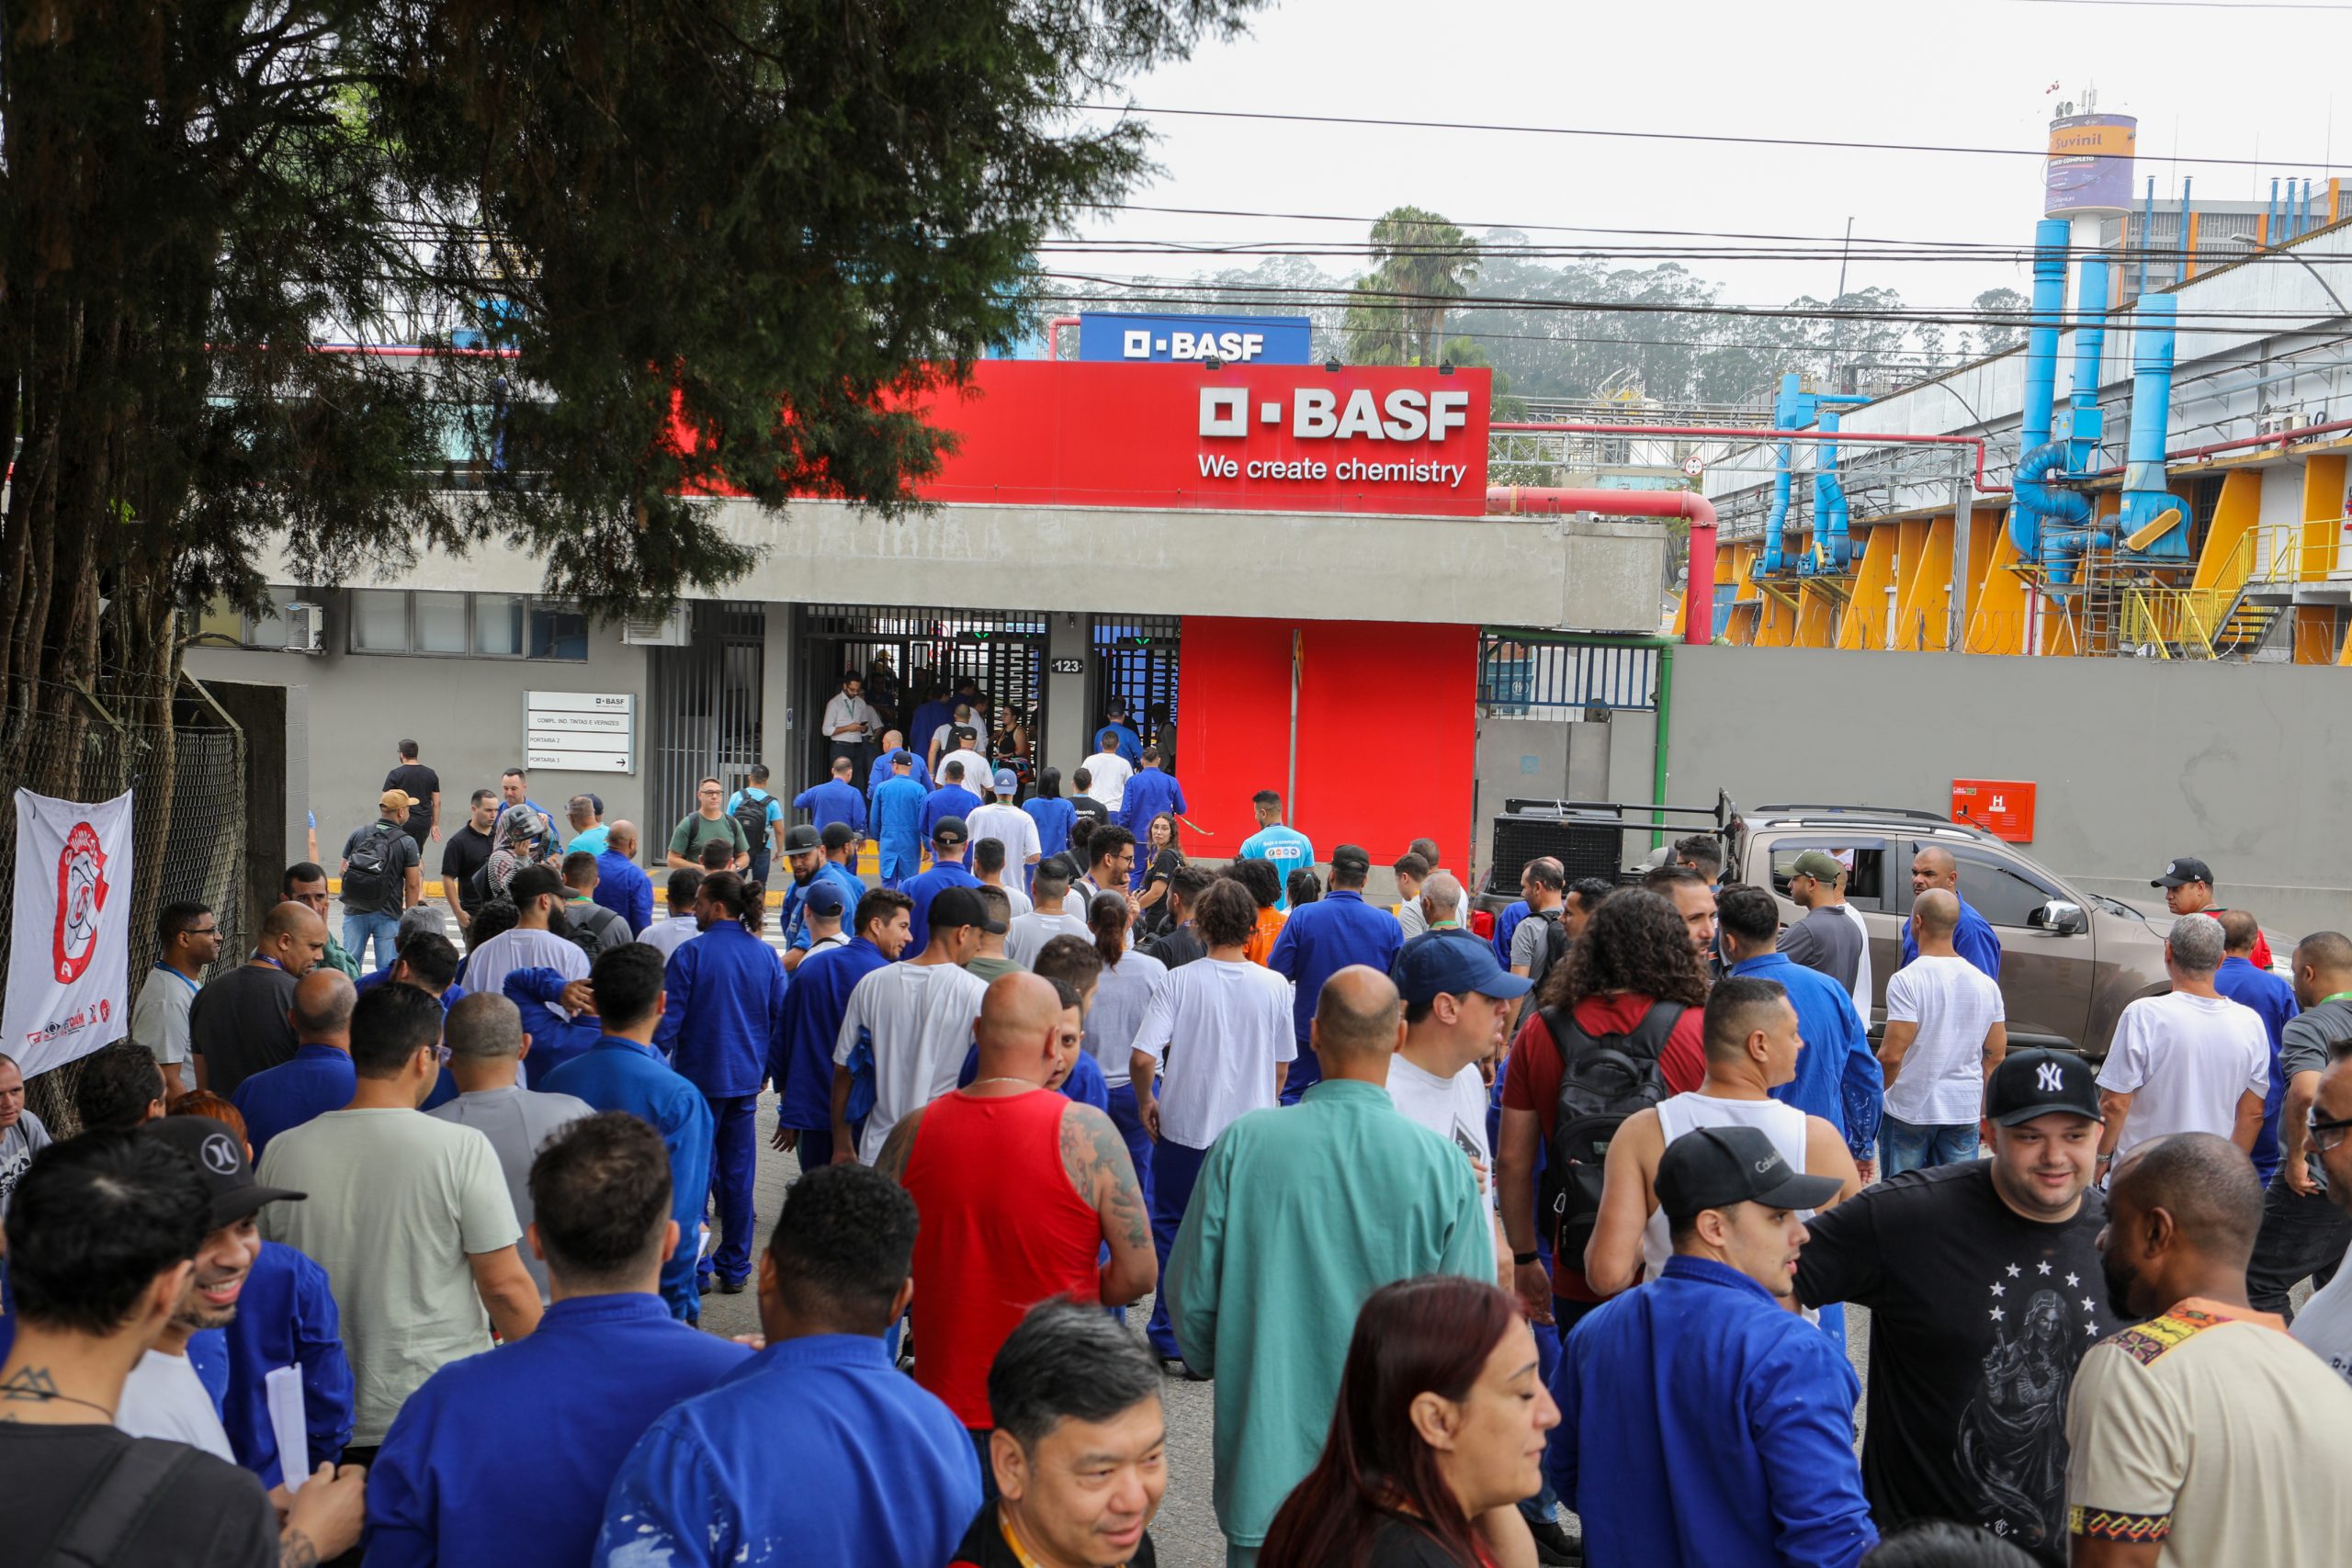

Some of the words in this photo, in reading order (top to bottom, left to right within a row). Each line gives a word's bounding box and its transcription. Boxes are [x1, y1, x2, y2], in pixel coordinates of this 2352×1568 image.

[2055, 133, 2102, 150] Suvinil
[1170, 332, 1264, 362] BASF
[1293, 388, 1469, 442] BASF
[1198, 455, 1238, 479] We
[1247, 457, 1328, 481] create
[1335, 457, 1467, 488] chemistry
[1055, 660, 1080, 672] 123
[1993, 795, 2003, 807] H
[2036, 1062, 2064, 1091] NY
